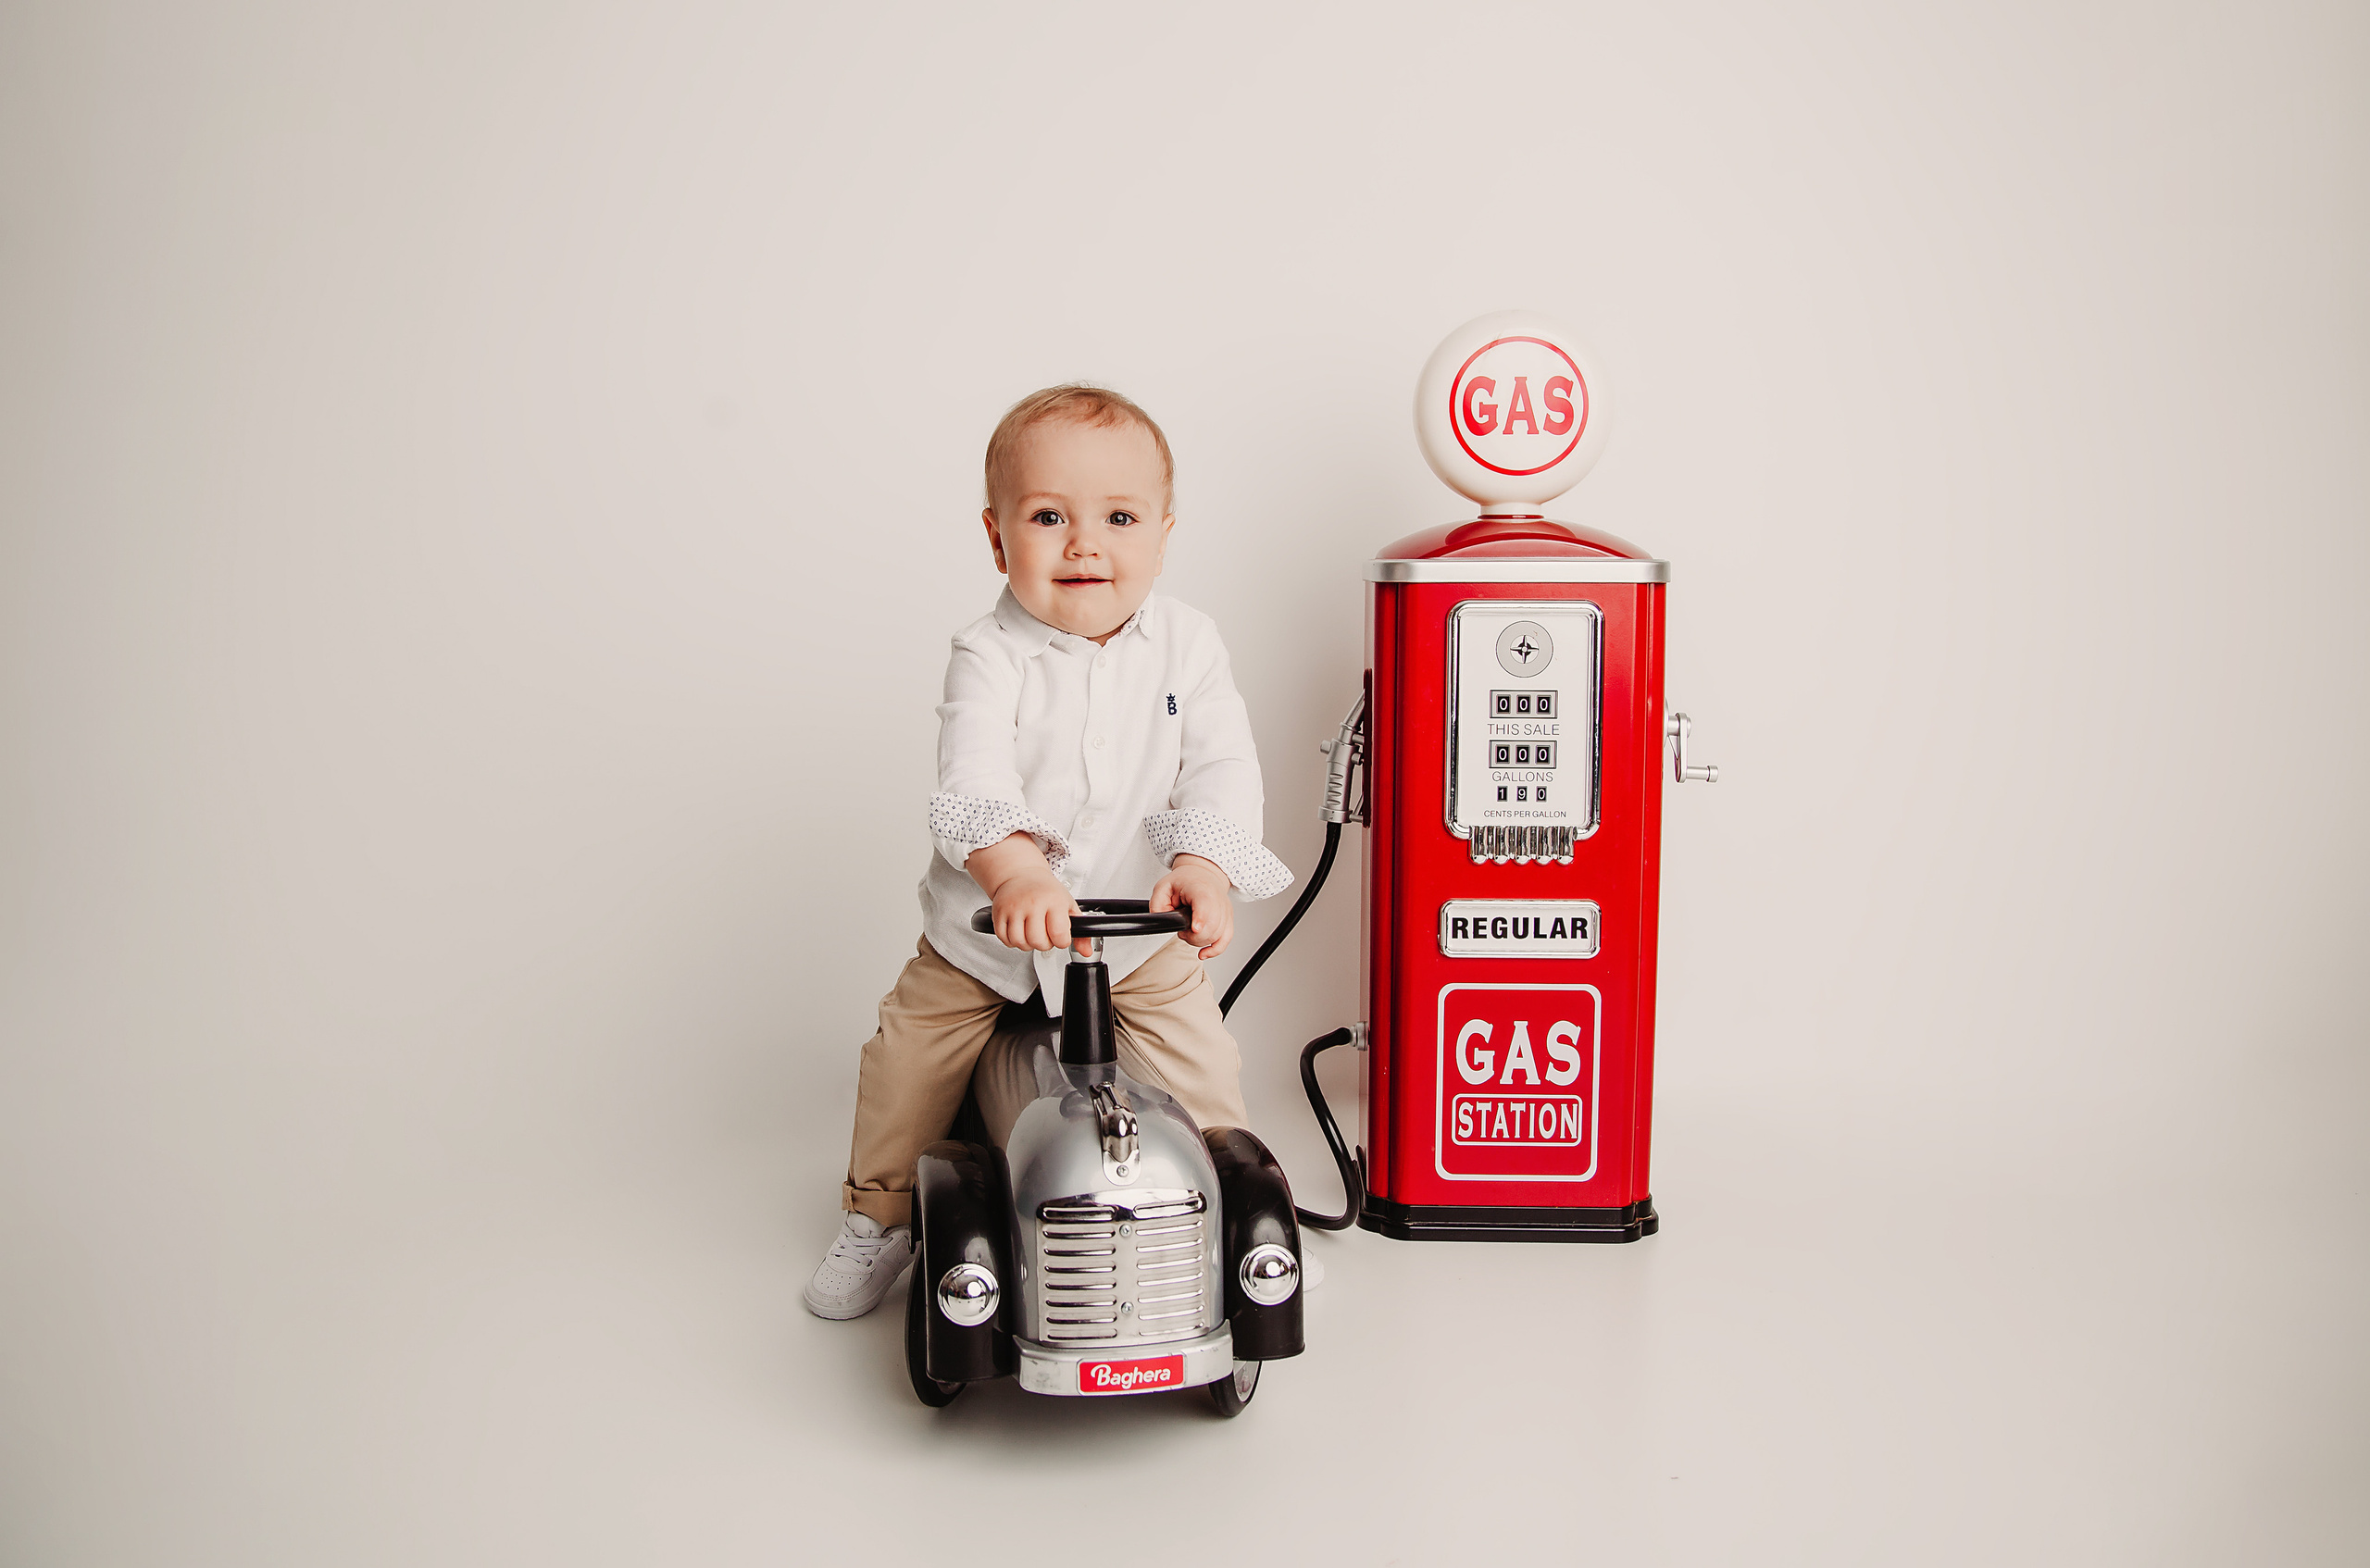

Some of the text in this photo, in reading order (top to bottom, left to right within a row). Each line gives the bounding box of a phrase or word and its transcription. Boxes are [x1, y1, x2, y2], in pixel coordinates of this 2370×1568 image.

[1462, 375, 1575, 436] GAS
[1166, 702, 1178, 716] B
[1487, 723, 1560, 736] THIS SALE
[1491, 771, 1553, 782] GALLONS
[1483, 810, 1566, 818] CENTS PER GALLON
[1452, 916, 1589, 940] REGULAR
[1455, 1018, 1581, 1086] GAS
[1457, 1101, 1578, 1139] STATION
[1090, 1363, 1171, 1389] Baghera
